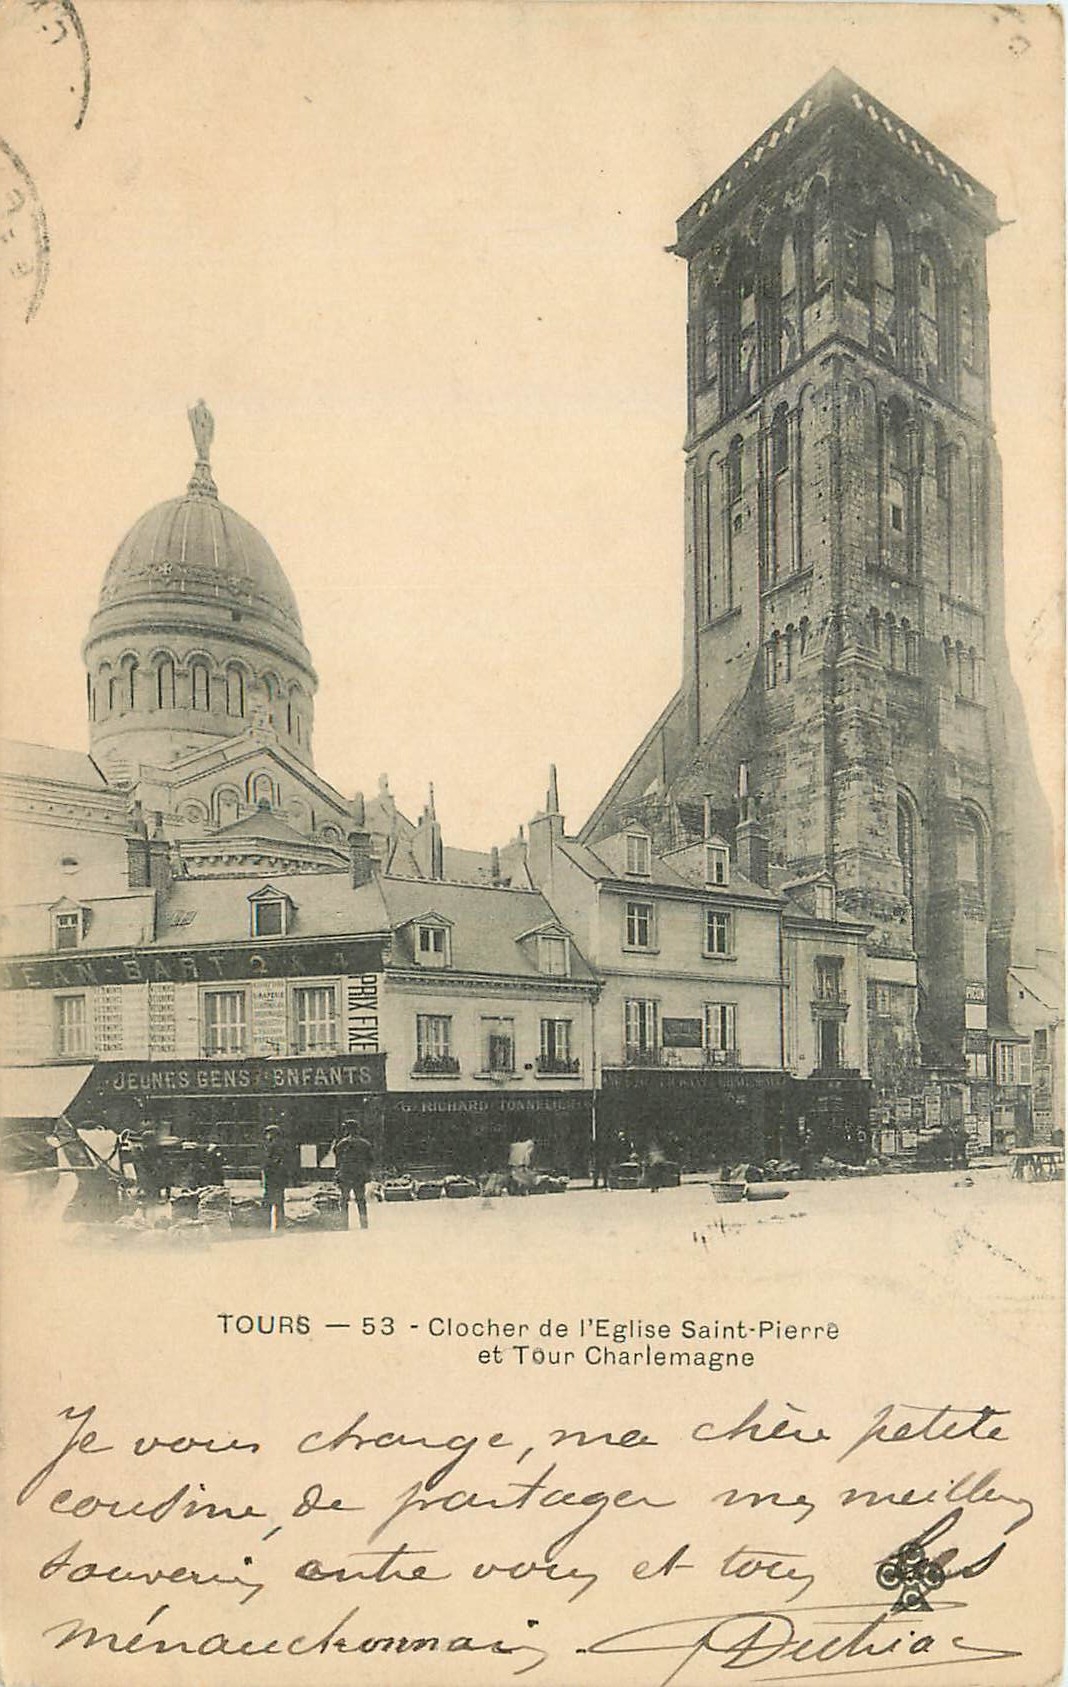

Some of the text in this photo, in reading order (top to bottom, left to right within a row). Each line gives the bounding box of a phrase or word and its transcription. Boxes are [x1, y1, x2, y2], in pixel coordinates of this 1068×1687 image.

[348, 974, 379, 1053] PRIX FIXE
[112, 1066, 373, 1091] JEUNES GENS ENFANTS
[421, 1099, 490, 1113] RICHARD
[17, 1404, 113, 1507] Je
[134, 1431, 261, 1457] vous
[548, 1427, 658, 1448] ma
[691, 1397, 831, 1444] chère
[838, 1403, 1012, 1463] petite
[291, 1483, 365, 1518] de
[367, 1462, 677, 1565] partager
[293, 1543, 453, 1585] entre
[471, 1557, 599, 1604] vous
[631, 1543, 694, 1581] et
[719, 1548, 817, 1604] tous
